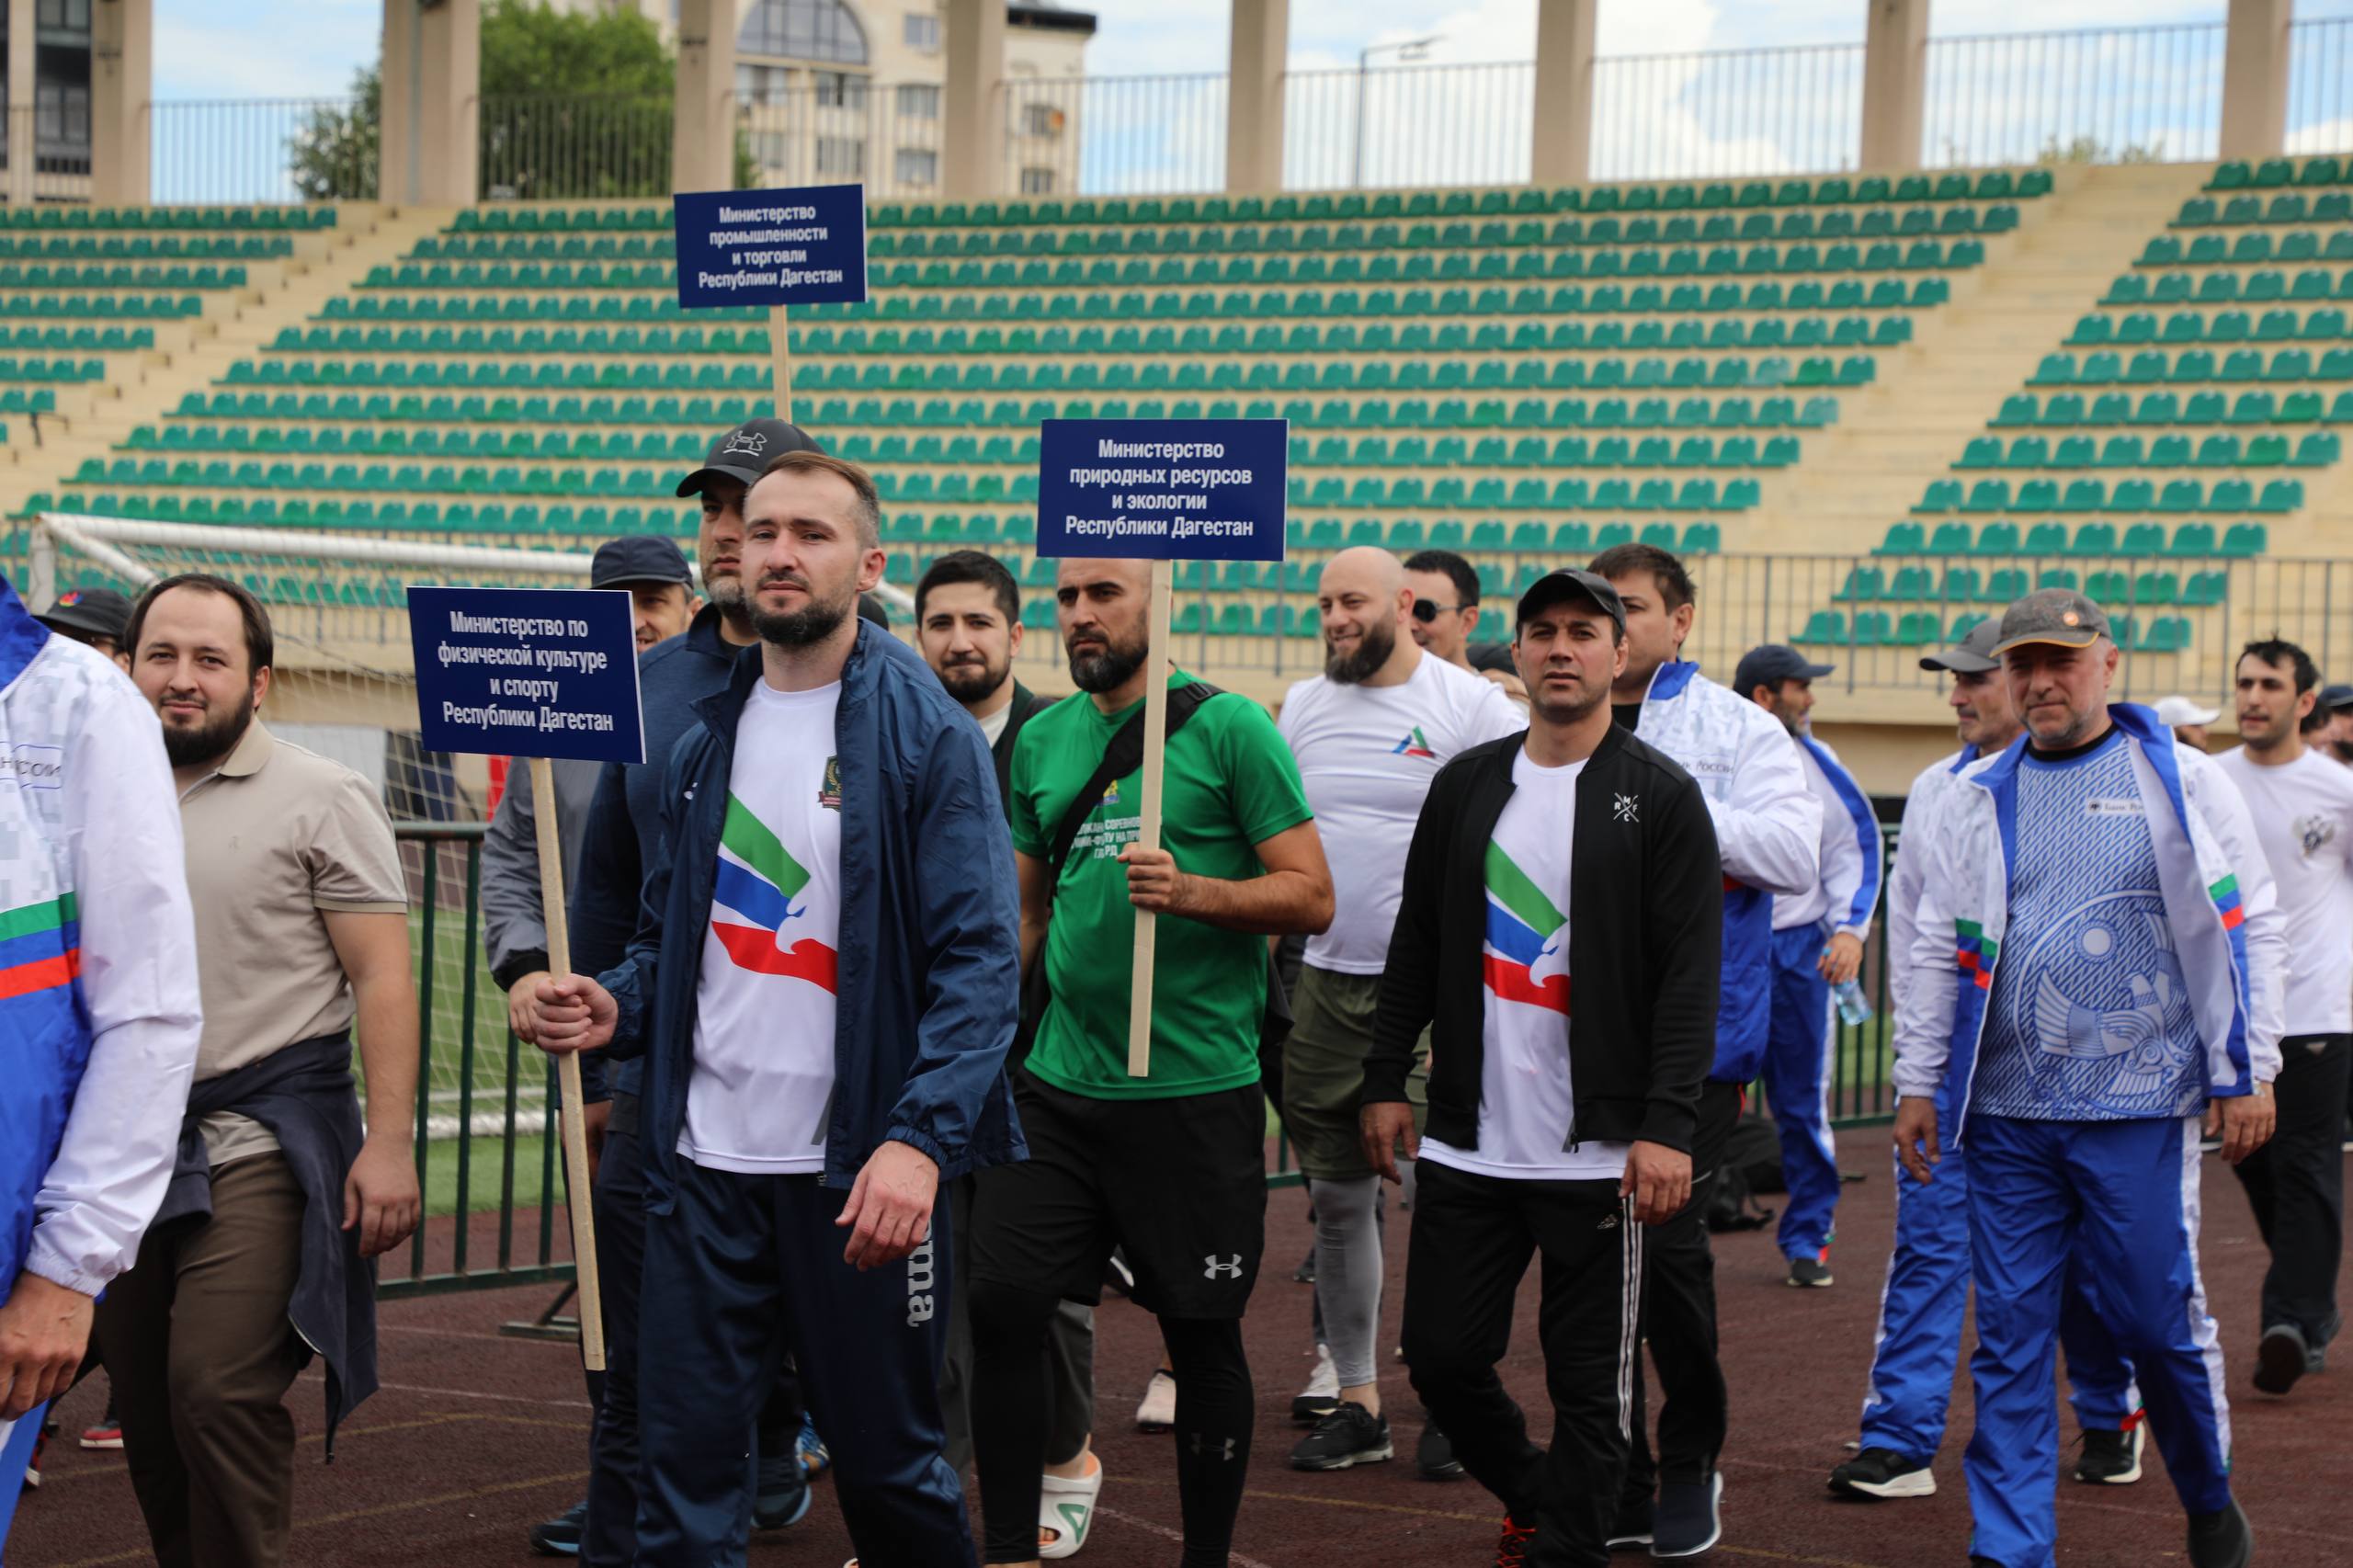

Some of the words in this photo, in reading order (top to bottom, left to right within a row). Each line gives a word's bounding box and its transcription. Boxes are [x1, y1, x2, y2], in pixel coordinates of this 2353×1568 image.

[720, 206, 816, 225] Министерство
[710, 227, 828, 249] промышленности
[732, 252, 742, 266] и
[744, 249, 807, 268] торговли
[699, 269, 778, 290] Республики
[780, 267, 843, 288] Дагестан
[1098, 438, 1225, 462] Министерство
[1069, 468, 1166, 488] природных
[1170, 469, 1253, 489] ресурсов
[1111, 494, 1123, 509] и
[1126, 494, 1208, 510] экологии
[1065, 515, 1168, 540] Республики
[1171, 517, 1254, 540] Дагестан
[449, 610, 564, 641] Министерство
[567, 619, 589, 638] по
[438, 640, 533, 668] физической
[535, 649, 608, 675] культуре
[489, 678, 501, 695] и
[503, 678, 559, 703] спорту
[442, 700, 536, 731] Республики
[539, 705, 614, 733] Дагестан
